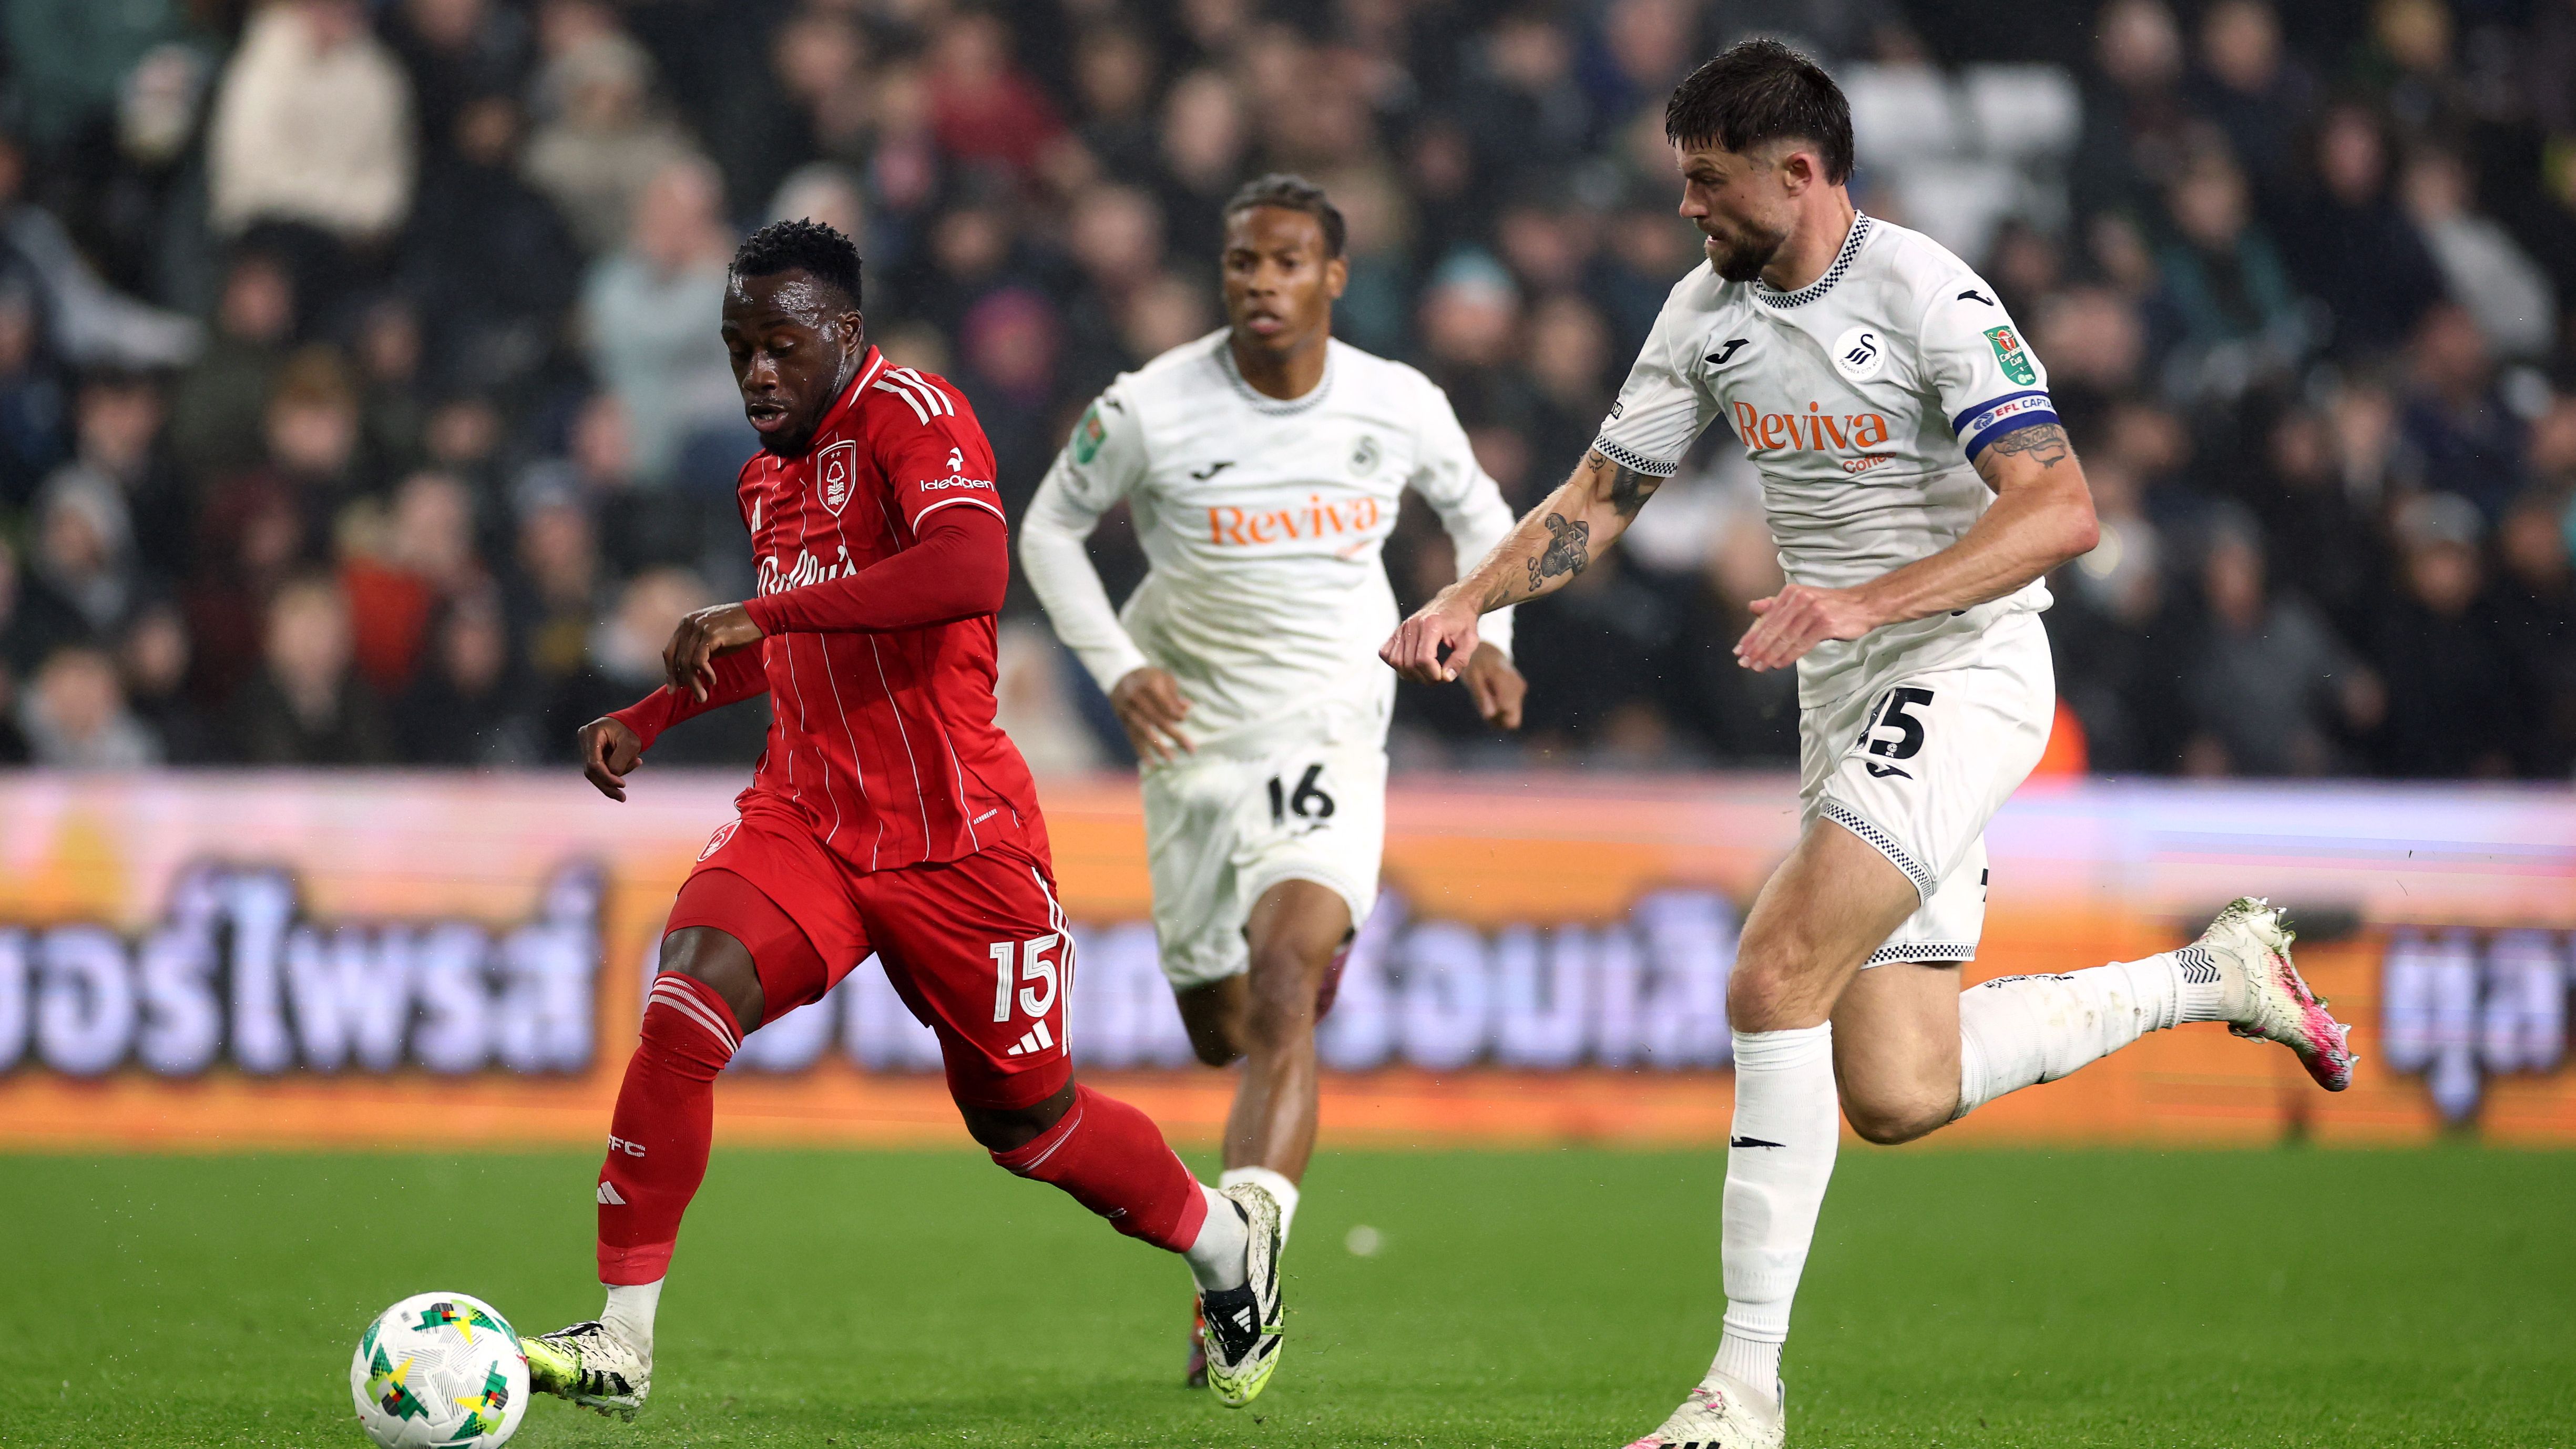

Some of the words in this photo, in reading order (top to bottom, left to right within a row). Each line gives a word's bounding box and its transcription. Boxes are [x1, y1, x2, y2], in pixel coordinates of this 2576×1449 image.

[1733, 401, 1889, 451] Reviva
[1995, 403, 2020, 416] EFL
[2022, 399, 2053, 409] CAPTA
[921, 475, 995, 492] Ideagen
[1208, 493, 1379, 546] Reviva
[1268, 764, 1335, 828] 16
[990, 933, 1059, 1023] 15
